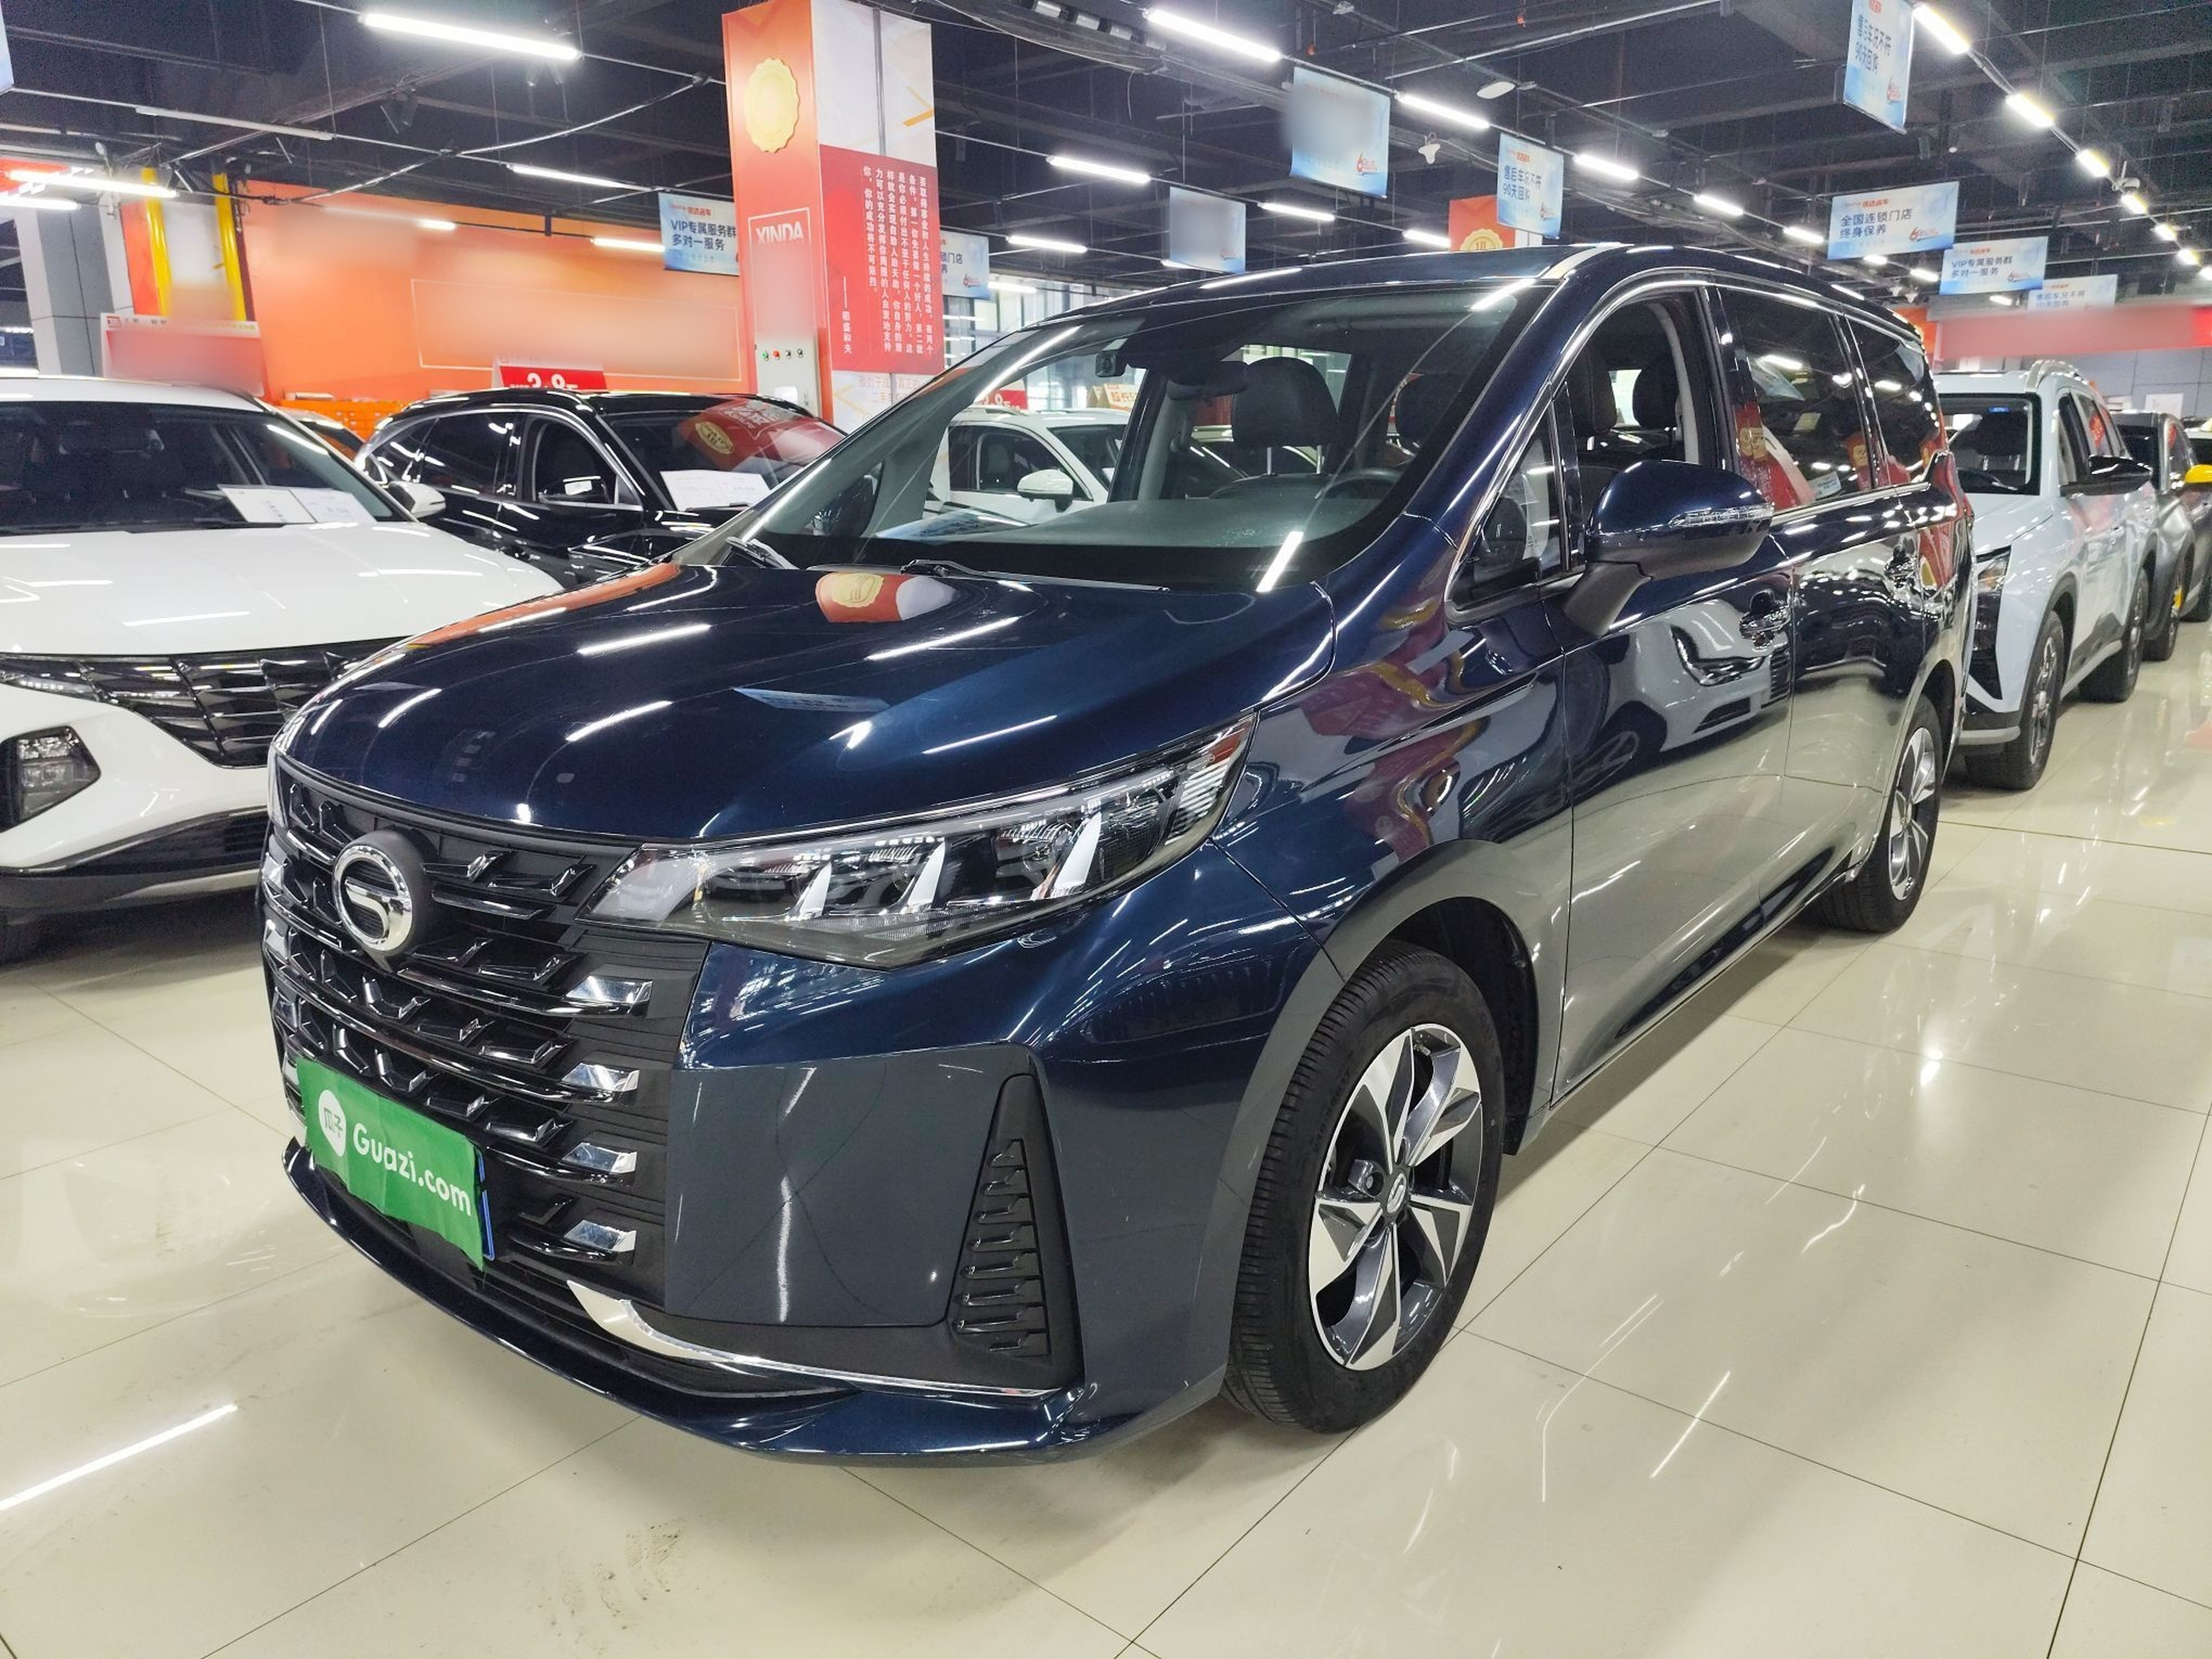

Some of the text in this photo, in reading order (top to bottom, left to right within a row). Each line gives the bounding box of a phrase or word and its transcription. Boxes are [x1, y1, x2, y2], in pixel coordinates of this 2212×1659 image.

[1840, 209, 1913, 227] 全国连锁门店
[671, 219, 737, 238] VIP专属服务群
[1839, 224, 1887, 240] 终身保养
[672, 233, 725, 251] 多对一服务
[353, 1123, 471, 1217] Guazi.com
